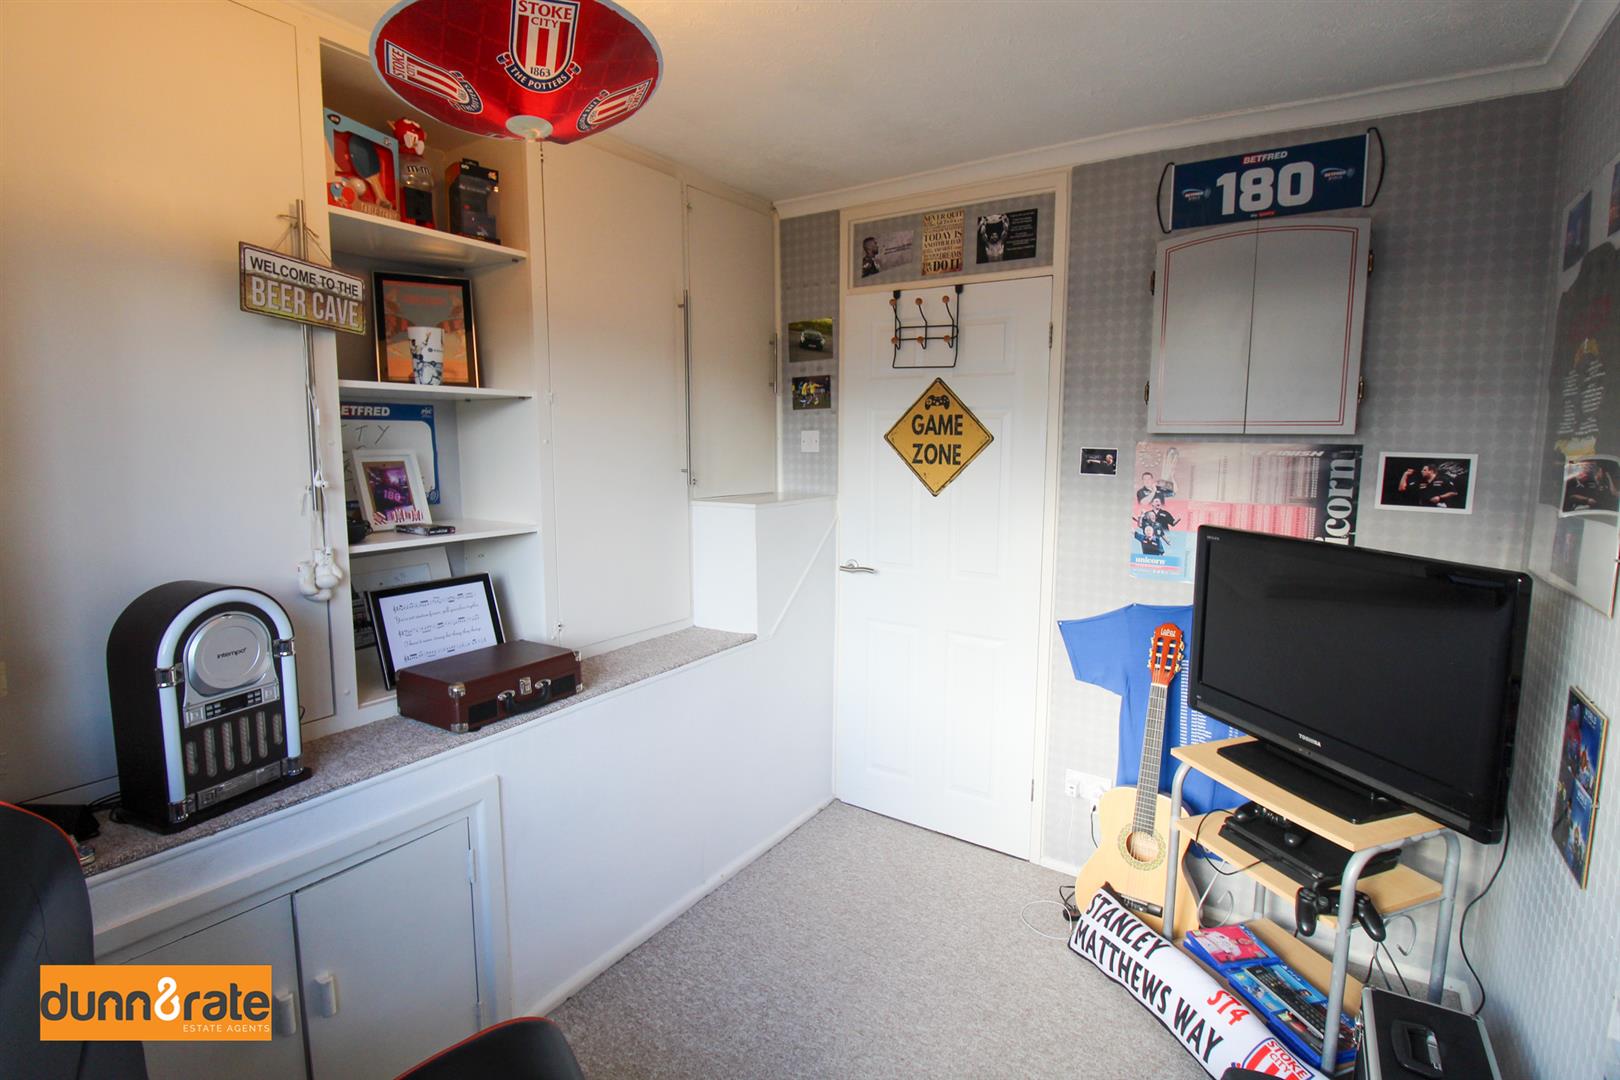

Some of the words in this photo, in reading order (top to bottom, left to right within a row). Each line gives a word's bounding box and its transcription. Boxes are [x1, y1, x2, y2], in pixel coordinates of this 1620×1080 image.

[518, 1, 573, 20] STOKE
[531, 17, 558, 28] CITY
[511, 67, 528, 84] THE
[527, 74, 568, 90] POTTERS
[530, 67, 551, 77] 1863
[1243, 151, 1288, 164] BETFRED
[1216, 161, 1315, 215] 180
[924, 231, 951, 242] TODAY
[250, 255, 316, 287] WELCOME
[319, 275, 335, 290] TO
[338, 280, 359, 297] THE
[251, 275, 306, 318] BEER
[312, 291, 359, 329] CAVE
[340, 405, 391, 417] ETFRED
[912, 414, 963, 436] GAME
[912, 443, 962, 465] ZONE
[1315, 458, 1356, 545] icorn
[1298, 732, 1322, 748] TOSHIBA
[1086, 893, 1172, 960] STANLEY
[1074, 919, 1172, 1016] MATTHEWS
[1173, 996, 1224, 1064] WAY
[1207, 988, 1250, 1026] ST4
[1267, 1040, 1309, 1079] STOKE
[1270, 1052, 1291, 1073] CITY
